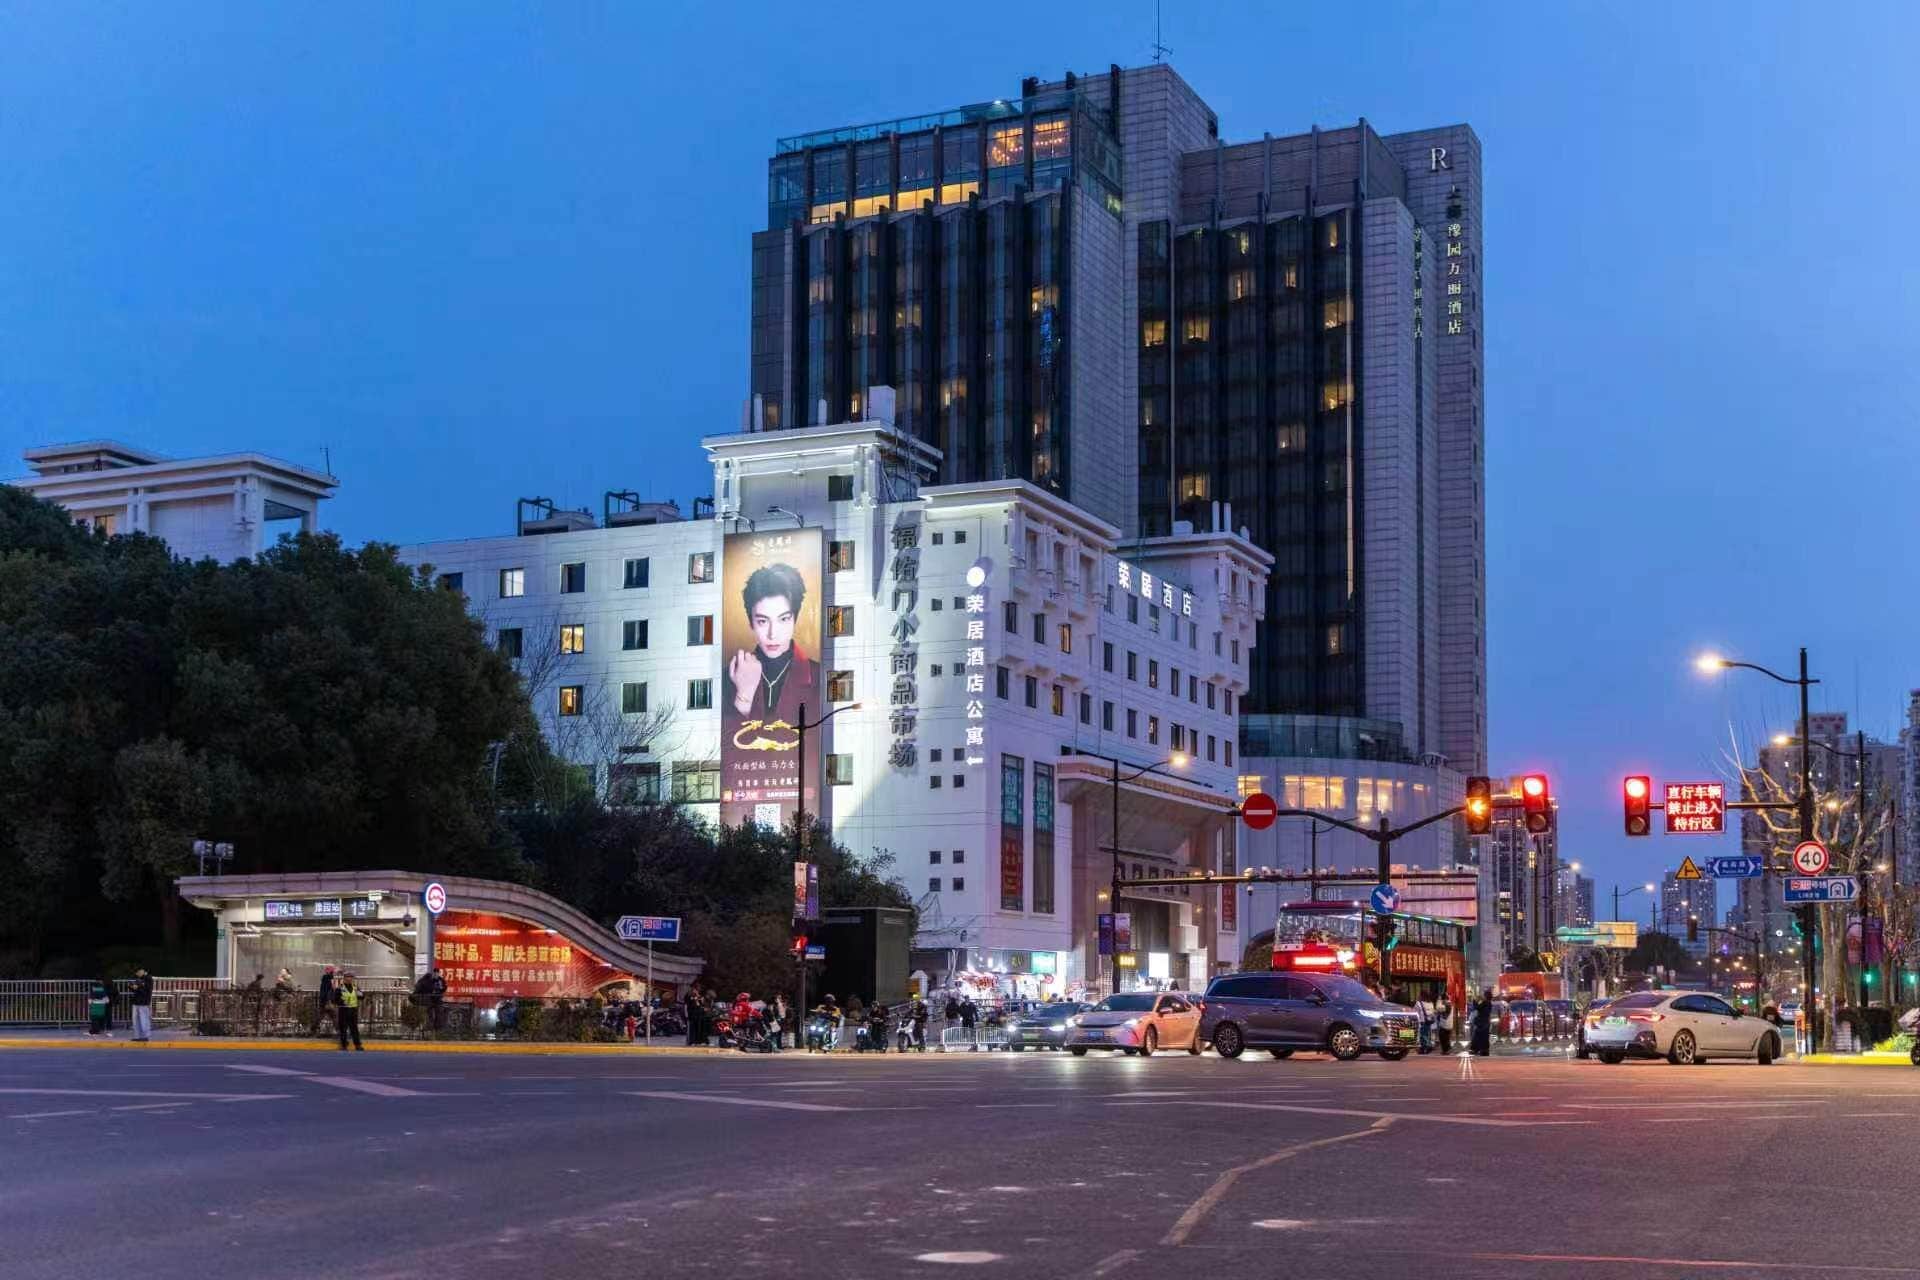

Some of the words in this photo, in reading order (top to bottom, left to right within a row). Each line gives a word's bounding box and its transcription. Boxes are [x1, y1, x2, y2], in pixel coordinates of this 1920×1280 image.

[1431, 147, 1448, 171] R
[1667, 785, 1722, 799] 直行车辆
[1667, 801, 1722, 815] 禁止进入
[1800, 851, 1822, 866] 40
